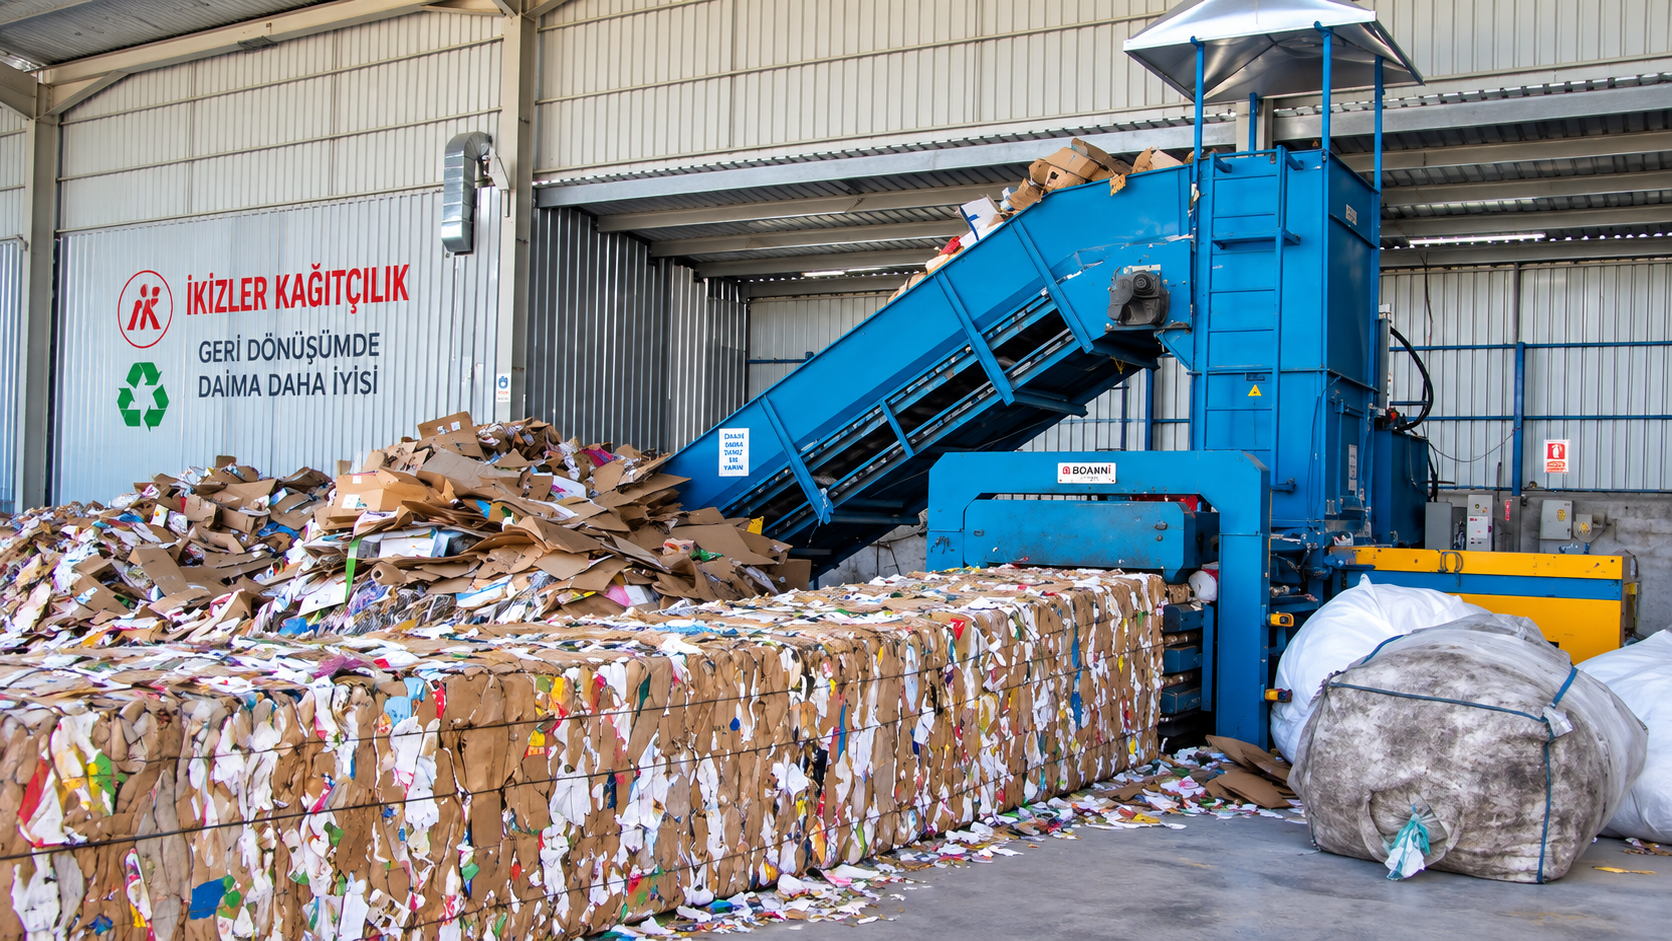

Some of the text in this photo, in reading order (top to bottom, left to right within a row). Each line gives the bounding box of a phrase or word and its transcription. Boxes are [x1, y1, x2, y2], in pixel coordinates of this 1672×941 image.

[187, 263, 409, 315] İKİZLER KAĞITÇILIK
[199, 330, 380, 365] GERİ DÖNÜŞÜMDE
[199, 365, 378, 398] DAİMA DAHA İYİSİ
